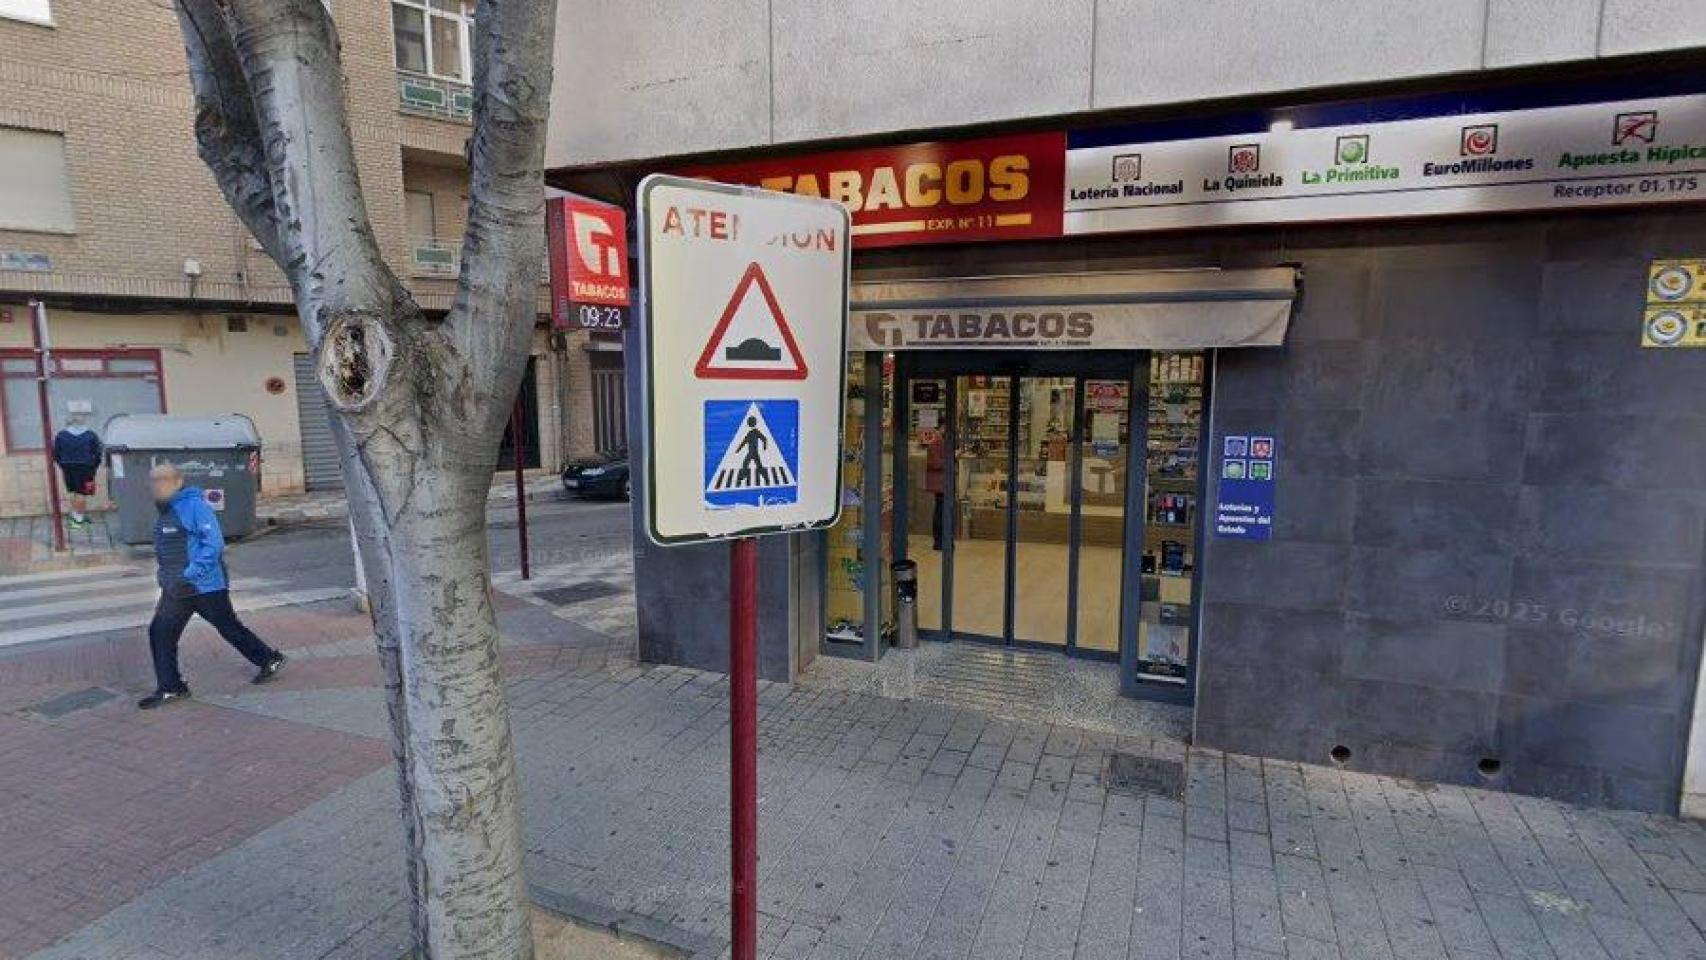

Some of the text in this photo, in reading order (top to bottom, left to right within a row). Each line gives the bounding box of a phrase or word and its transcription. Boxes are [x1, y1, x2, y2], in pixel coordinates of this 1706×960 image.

[1423, 157, 1534, 176] EuroMillones
[1558, 149, 1640, 169] Apuesta
[1204, 172, 1283, 192] La Quiniela
[1302, 164, 1400, 184] La Primitiva
[1123, 180, 1184, 197] Nacional
[1554, 182, 1634, 198] Receptor
[571, 281, 626, 299] TABACOS
[579, 305, 621, 327] 09:23
[911, 312, 1095, 339] TABACOS
[1257, 516, 1270, 524] del
